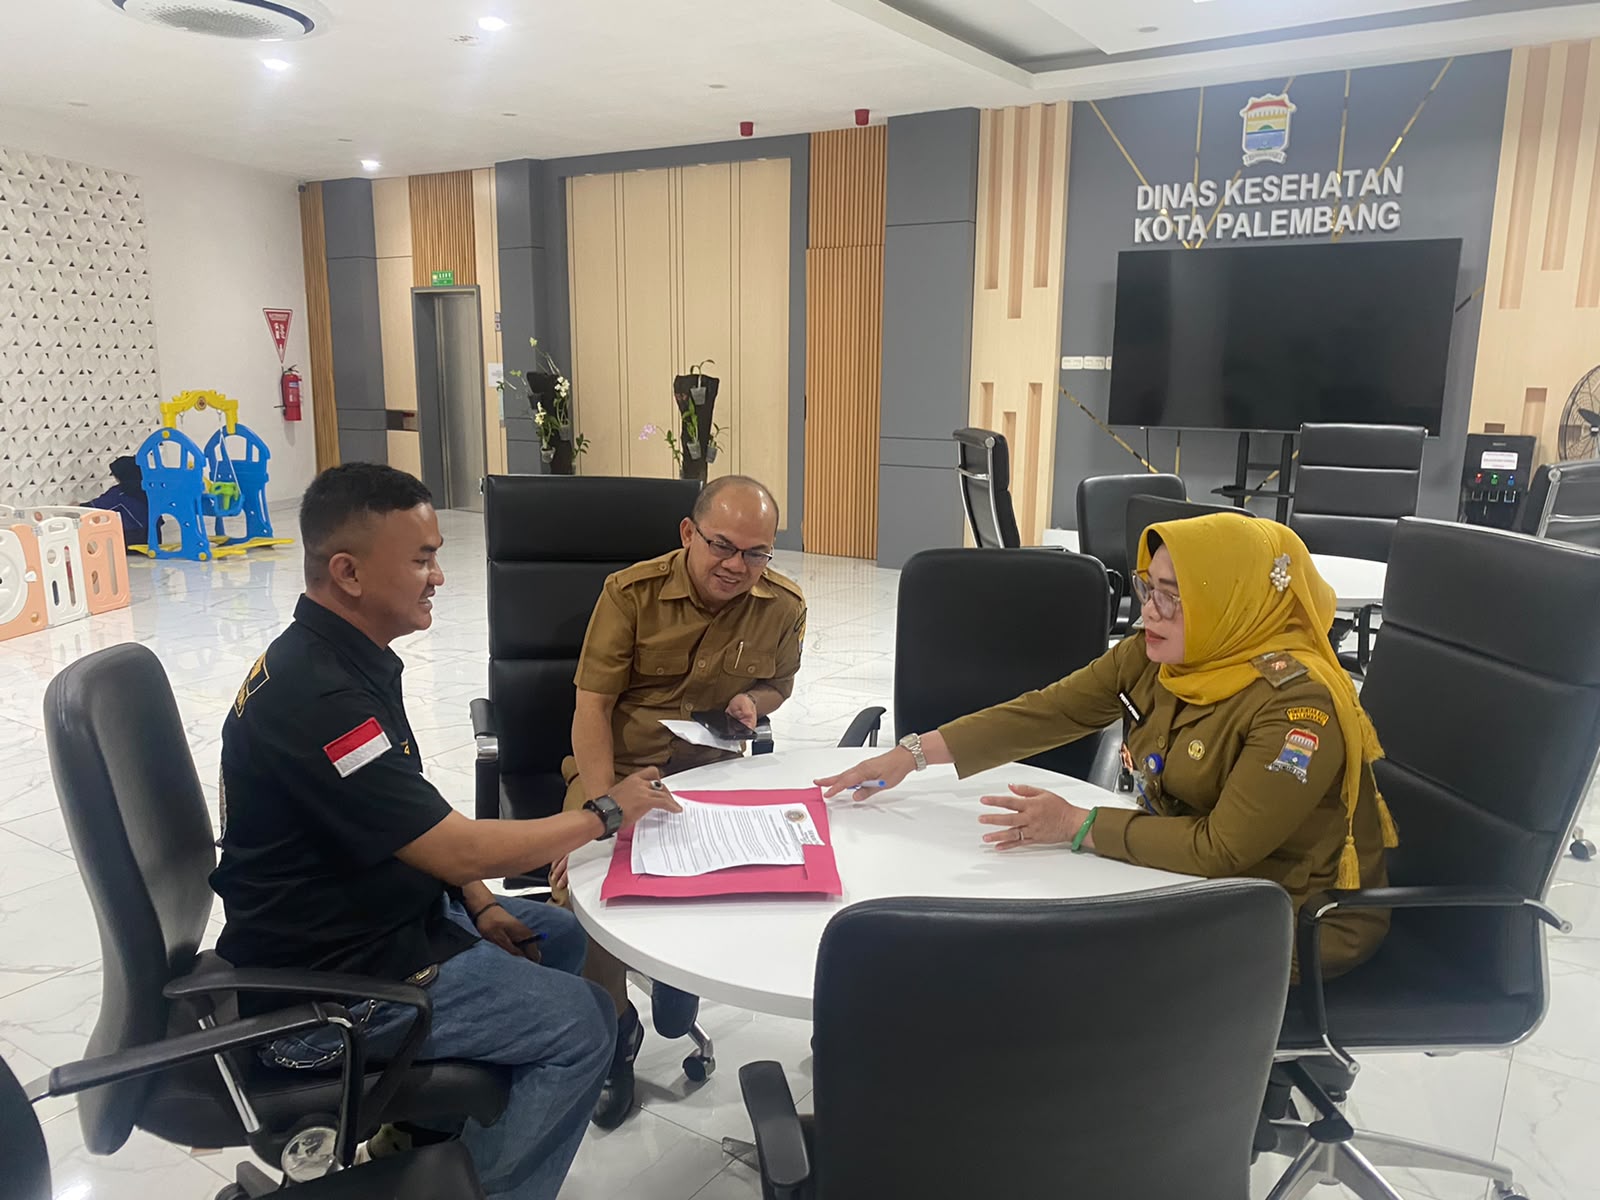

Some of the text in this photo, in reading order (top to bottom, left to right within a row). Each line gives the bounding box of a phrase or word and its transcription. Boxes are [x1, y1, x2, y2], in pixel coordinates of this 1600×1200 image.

[1137, 166, 1404, 211] DINAS KESEHATAN
[1134, 201, 1401, 243] KOTA PALEMBANG
